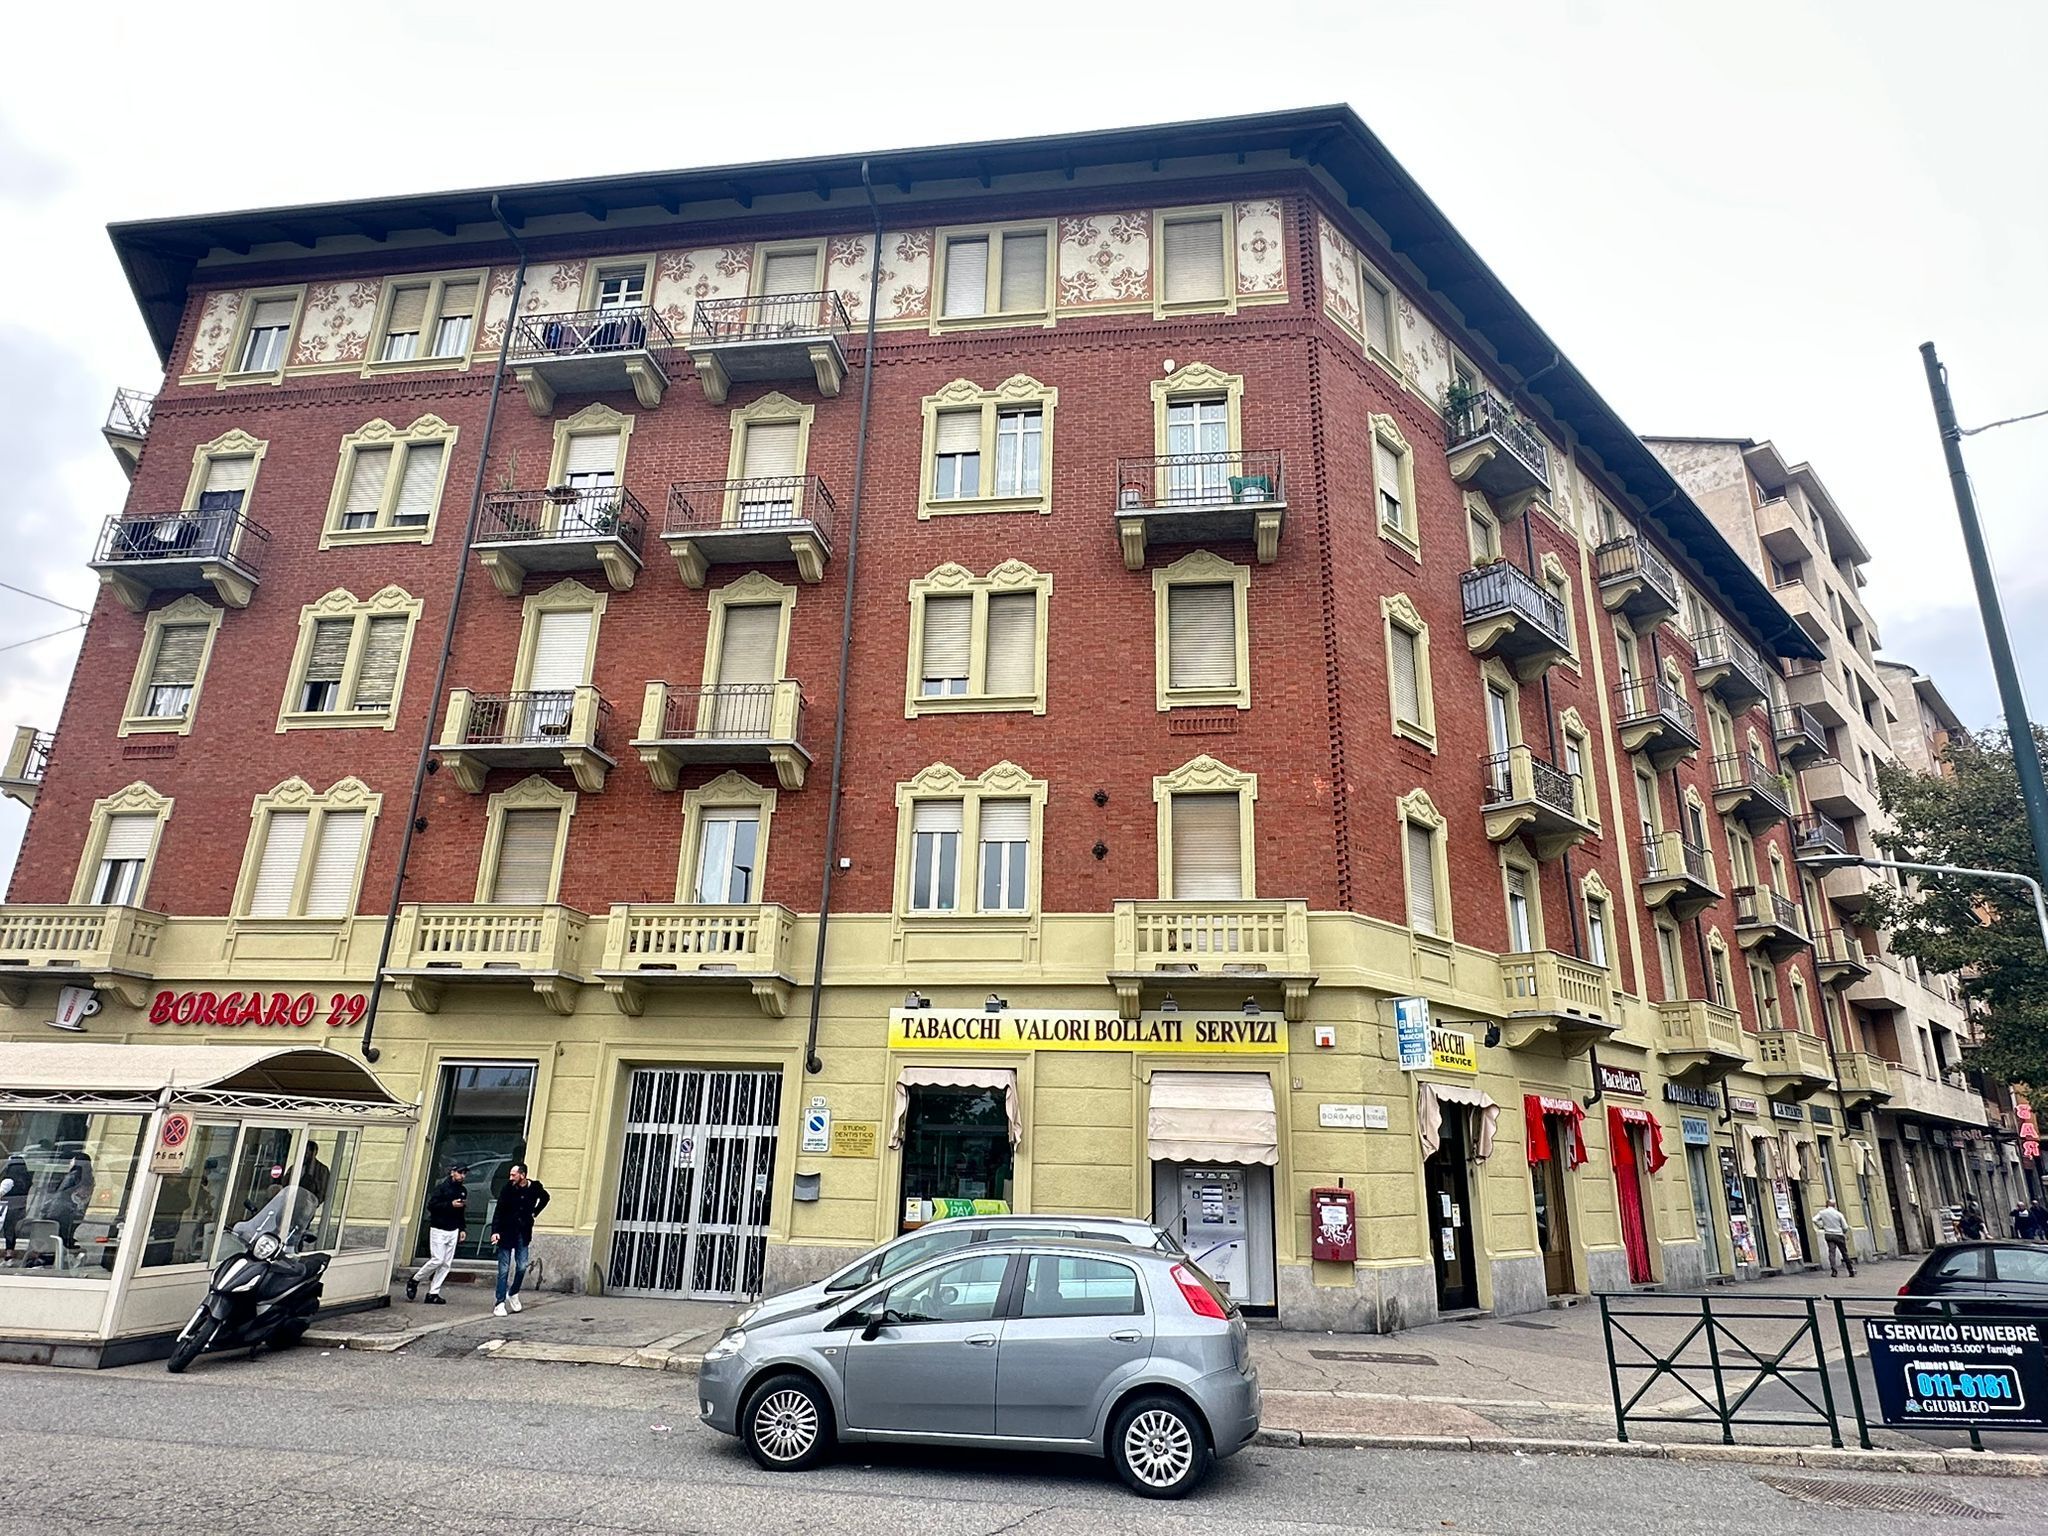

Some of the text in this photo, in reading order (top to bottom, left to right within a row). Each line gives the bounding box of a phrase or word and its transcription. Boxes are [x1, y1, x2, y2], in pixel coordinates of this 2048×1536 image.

[149, 991, 368, 1026] BORGARO 29
[901, 1017, 1277, 1043] TABACCHI VALORI BOLLATI SERVIZI
[1401, 1054, 1425, 1064] LOTTO
[1440, 1055, 1472, 1066] SERVICE
[1600, 1067, 1641, 1092] Macelleria
[950, 1206, 971, 1216] PAY
[1867, 1323, 2039, 1342] IL SERVIZIO FUNEBRE
[1889, 1343, 1915, 1352] scelto
[1916, 1343, 1928, 1353] da
[1929, 1344, 1949, 1353] oltre
[1913, 1360, 1948, 1371] Numero
[1917, 1373, 2012, 1398] 011-8181
[1922, 1400, 1990, 1413] GIUBILEO
